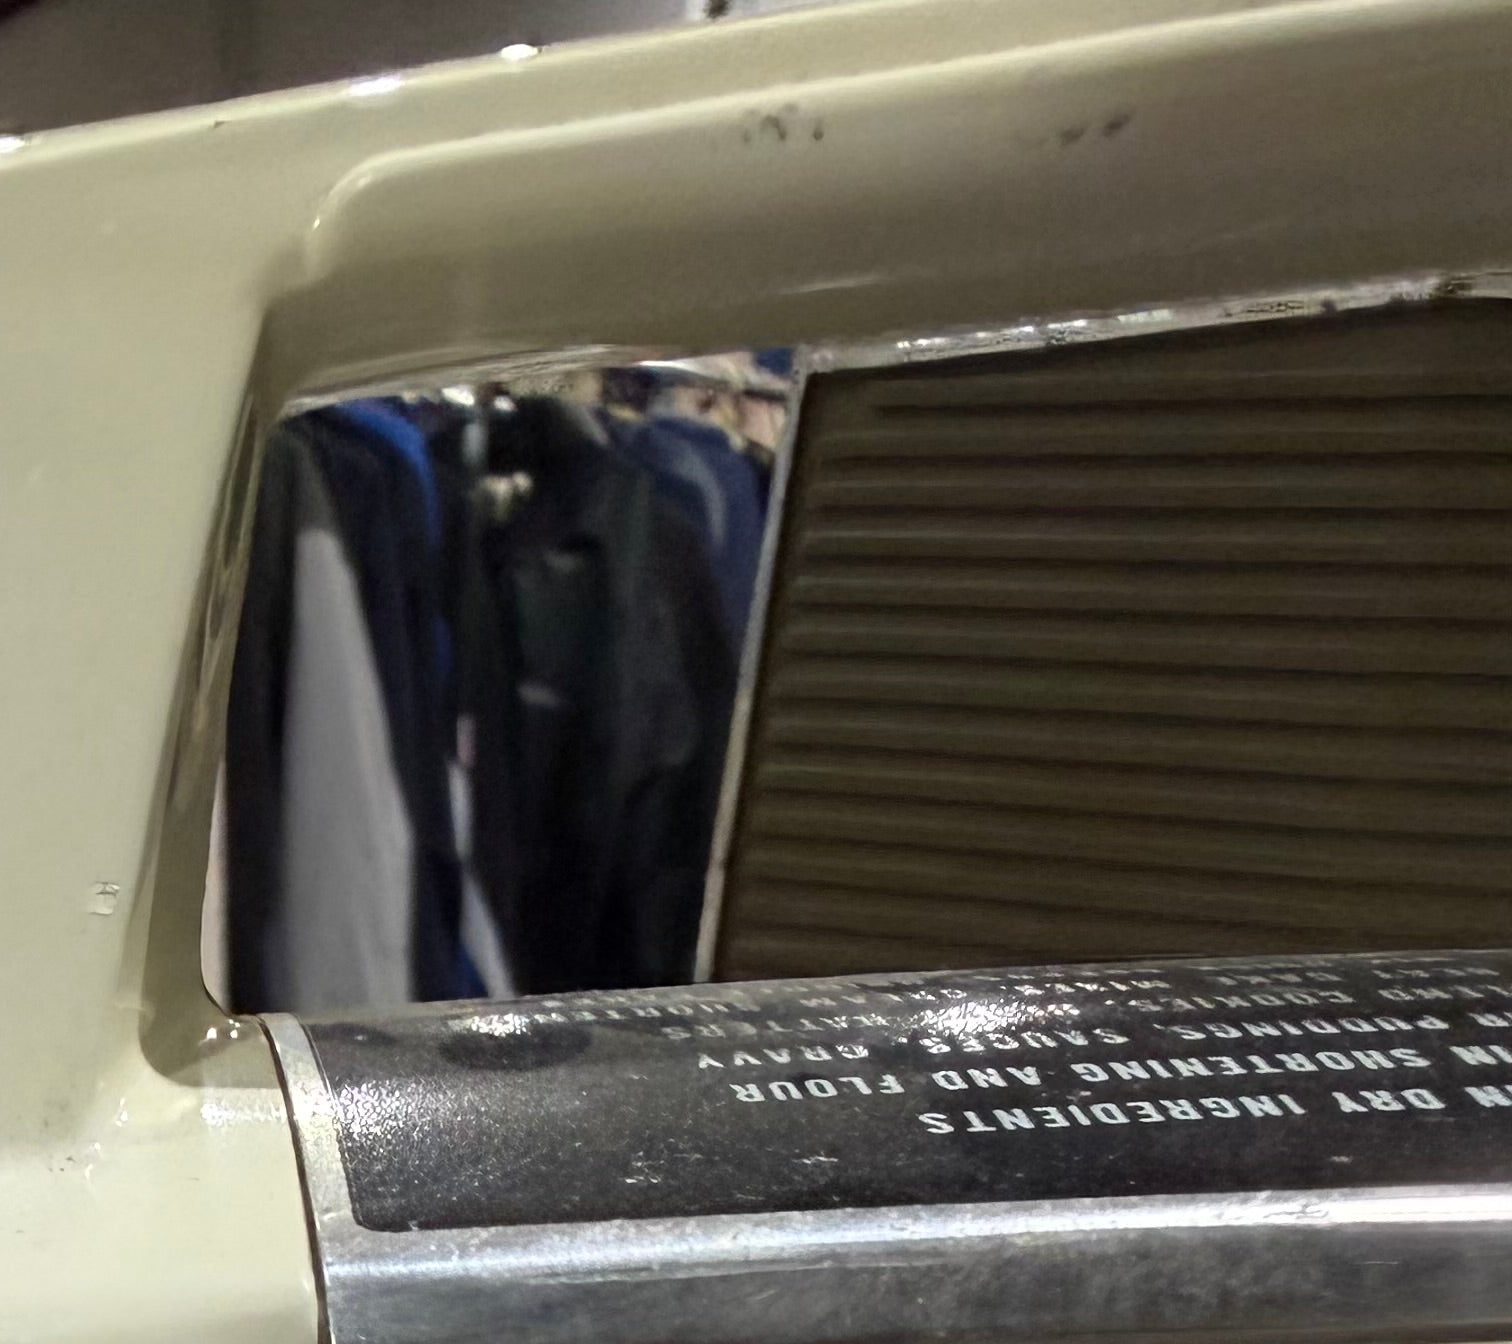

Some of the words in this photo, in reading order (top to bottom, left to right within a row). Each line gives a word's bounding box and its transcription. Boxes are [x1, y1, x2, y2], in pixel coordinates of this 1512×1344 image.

[1152, 1014, 1450, 1041] PUDDINGS,
[698, 1044, 869, 1069] GRAVY
[1070, 1047, 1432, 1083] SHORTENING
[729, 1073, 906, 1102] FLOUR
[931, 1065, 1042, 1091] AND
[1331, 1087, 1447, 1113] DRY
[917, 1094, 1307, 1134] INGREDIENTS
